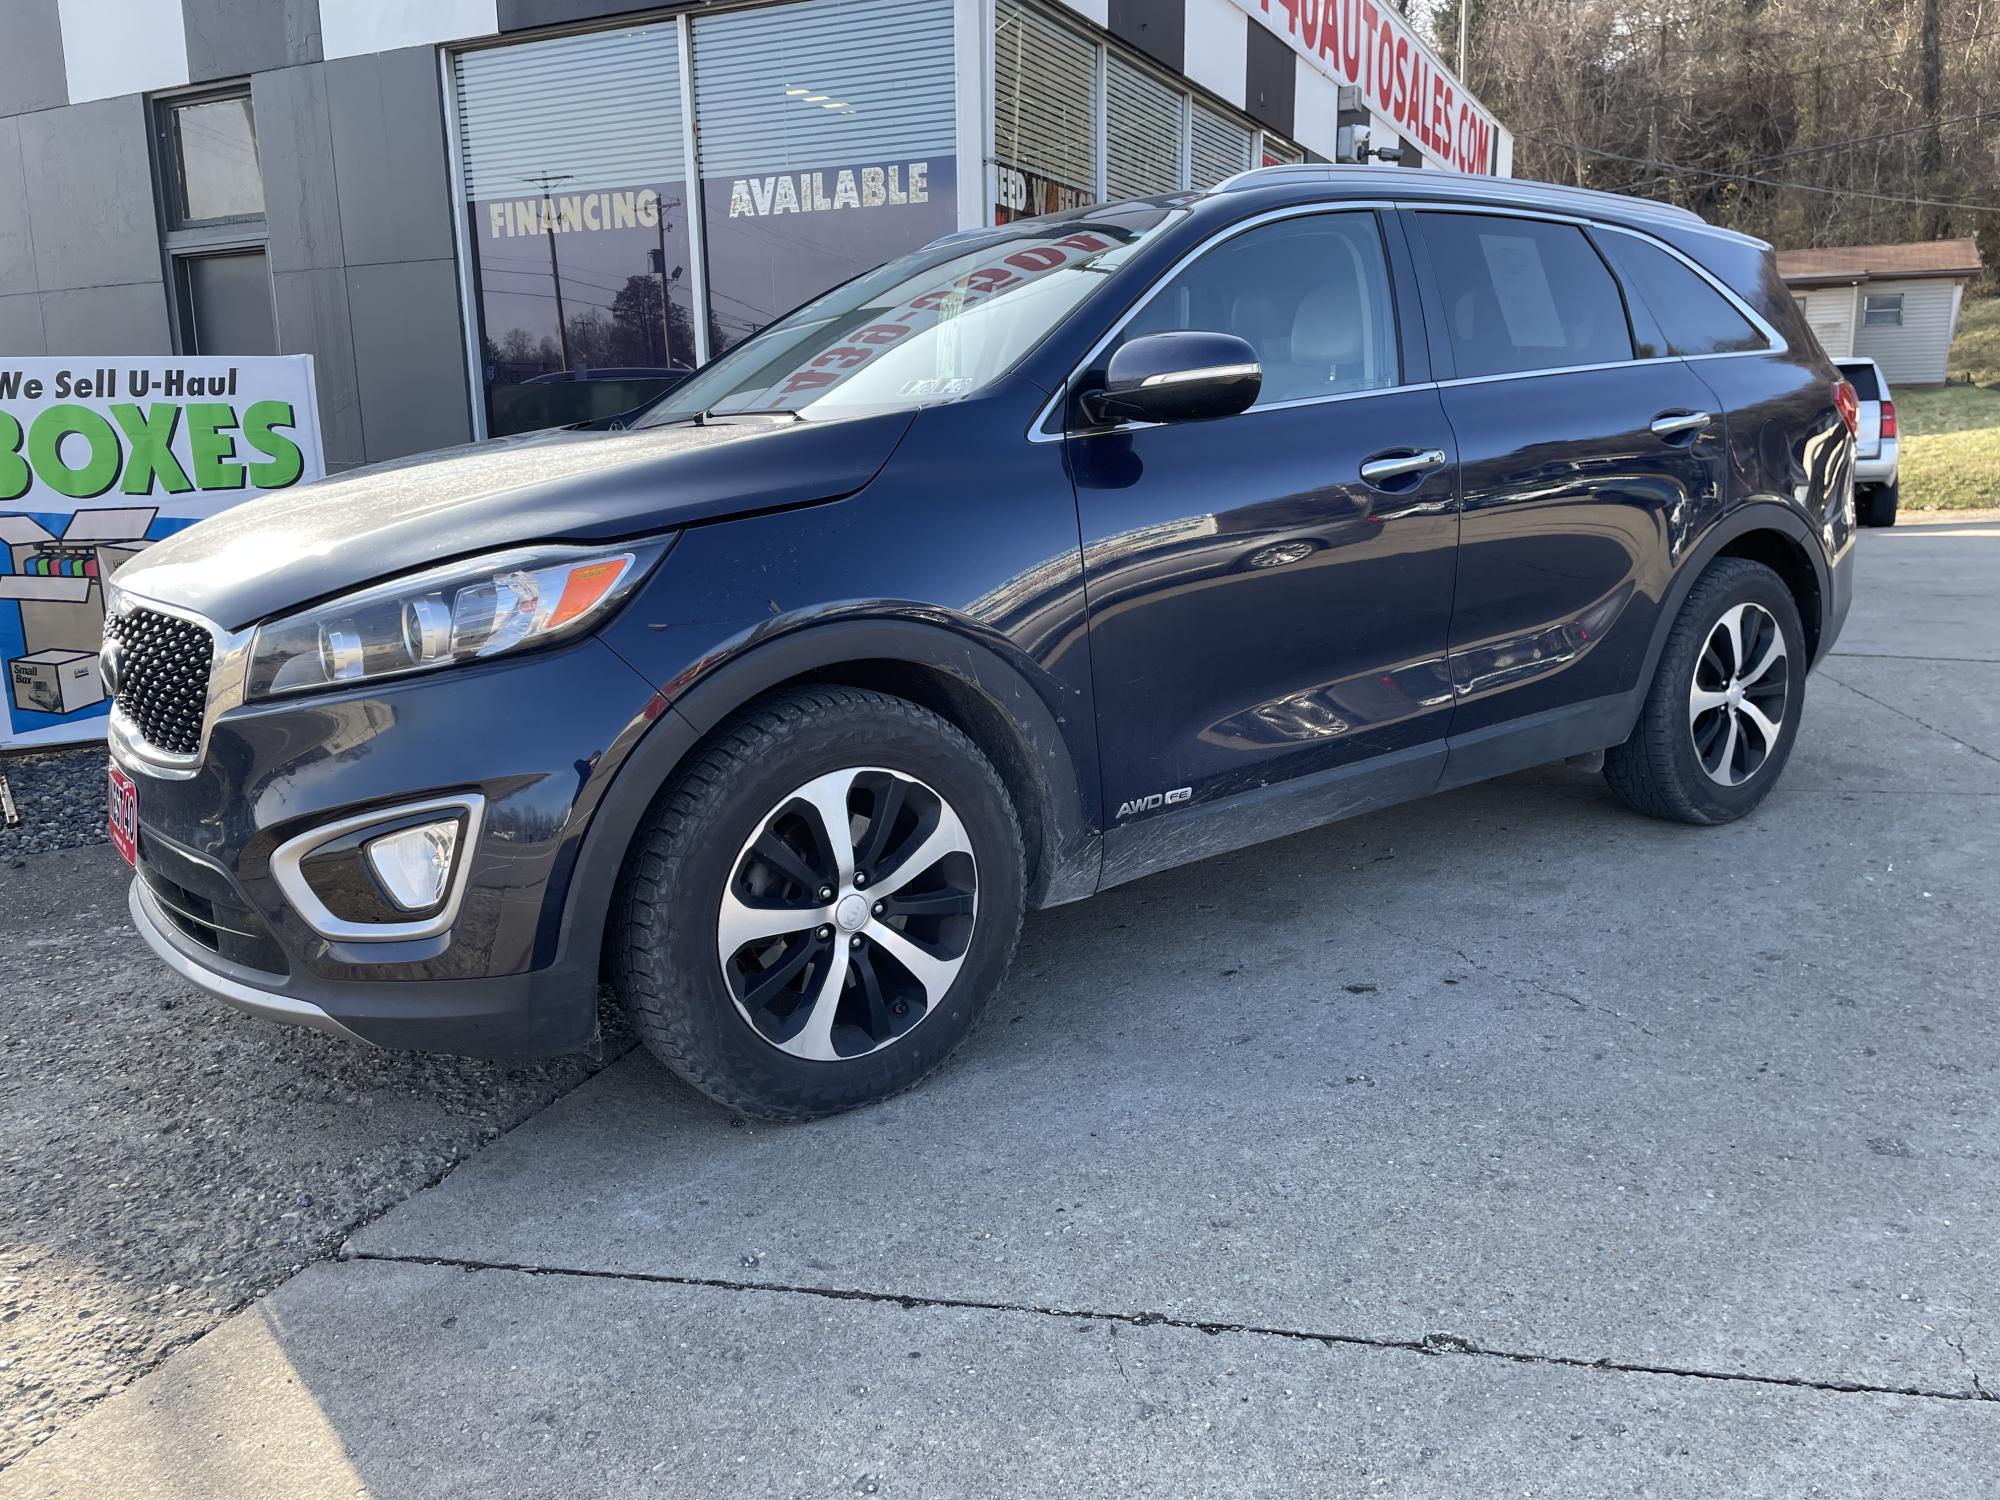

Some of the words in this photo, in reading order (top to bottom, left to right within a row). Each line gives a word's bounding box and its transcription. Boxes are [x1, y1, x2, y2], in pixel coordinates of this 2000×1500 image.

[1261, 0, 1489, 175] AUTOSALES.COM
[729, 162, 929, 218] AVAILABLE
[995, 163, 1026, 211] EED
[489, 189, 660, 238] FINANCING
[0, 371, 43, 399] We
[55, 369, 116, 398] Sell
[129, 368, 237, 397] U-Haul
[14, 664, 38, 676] Small
[16, 674, 32, 685] Box
[1115, 793, 1163, 819] AWD
